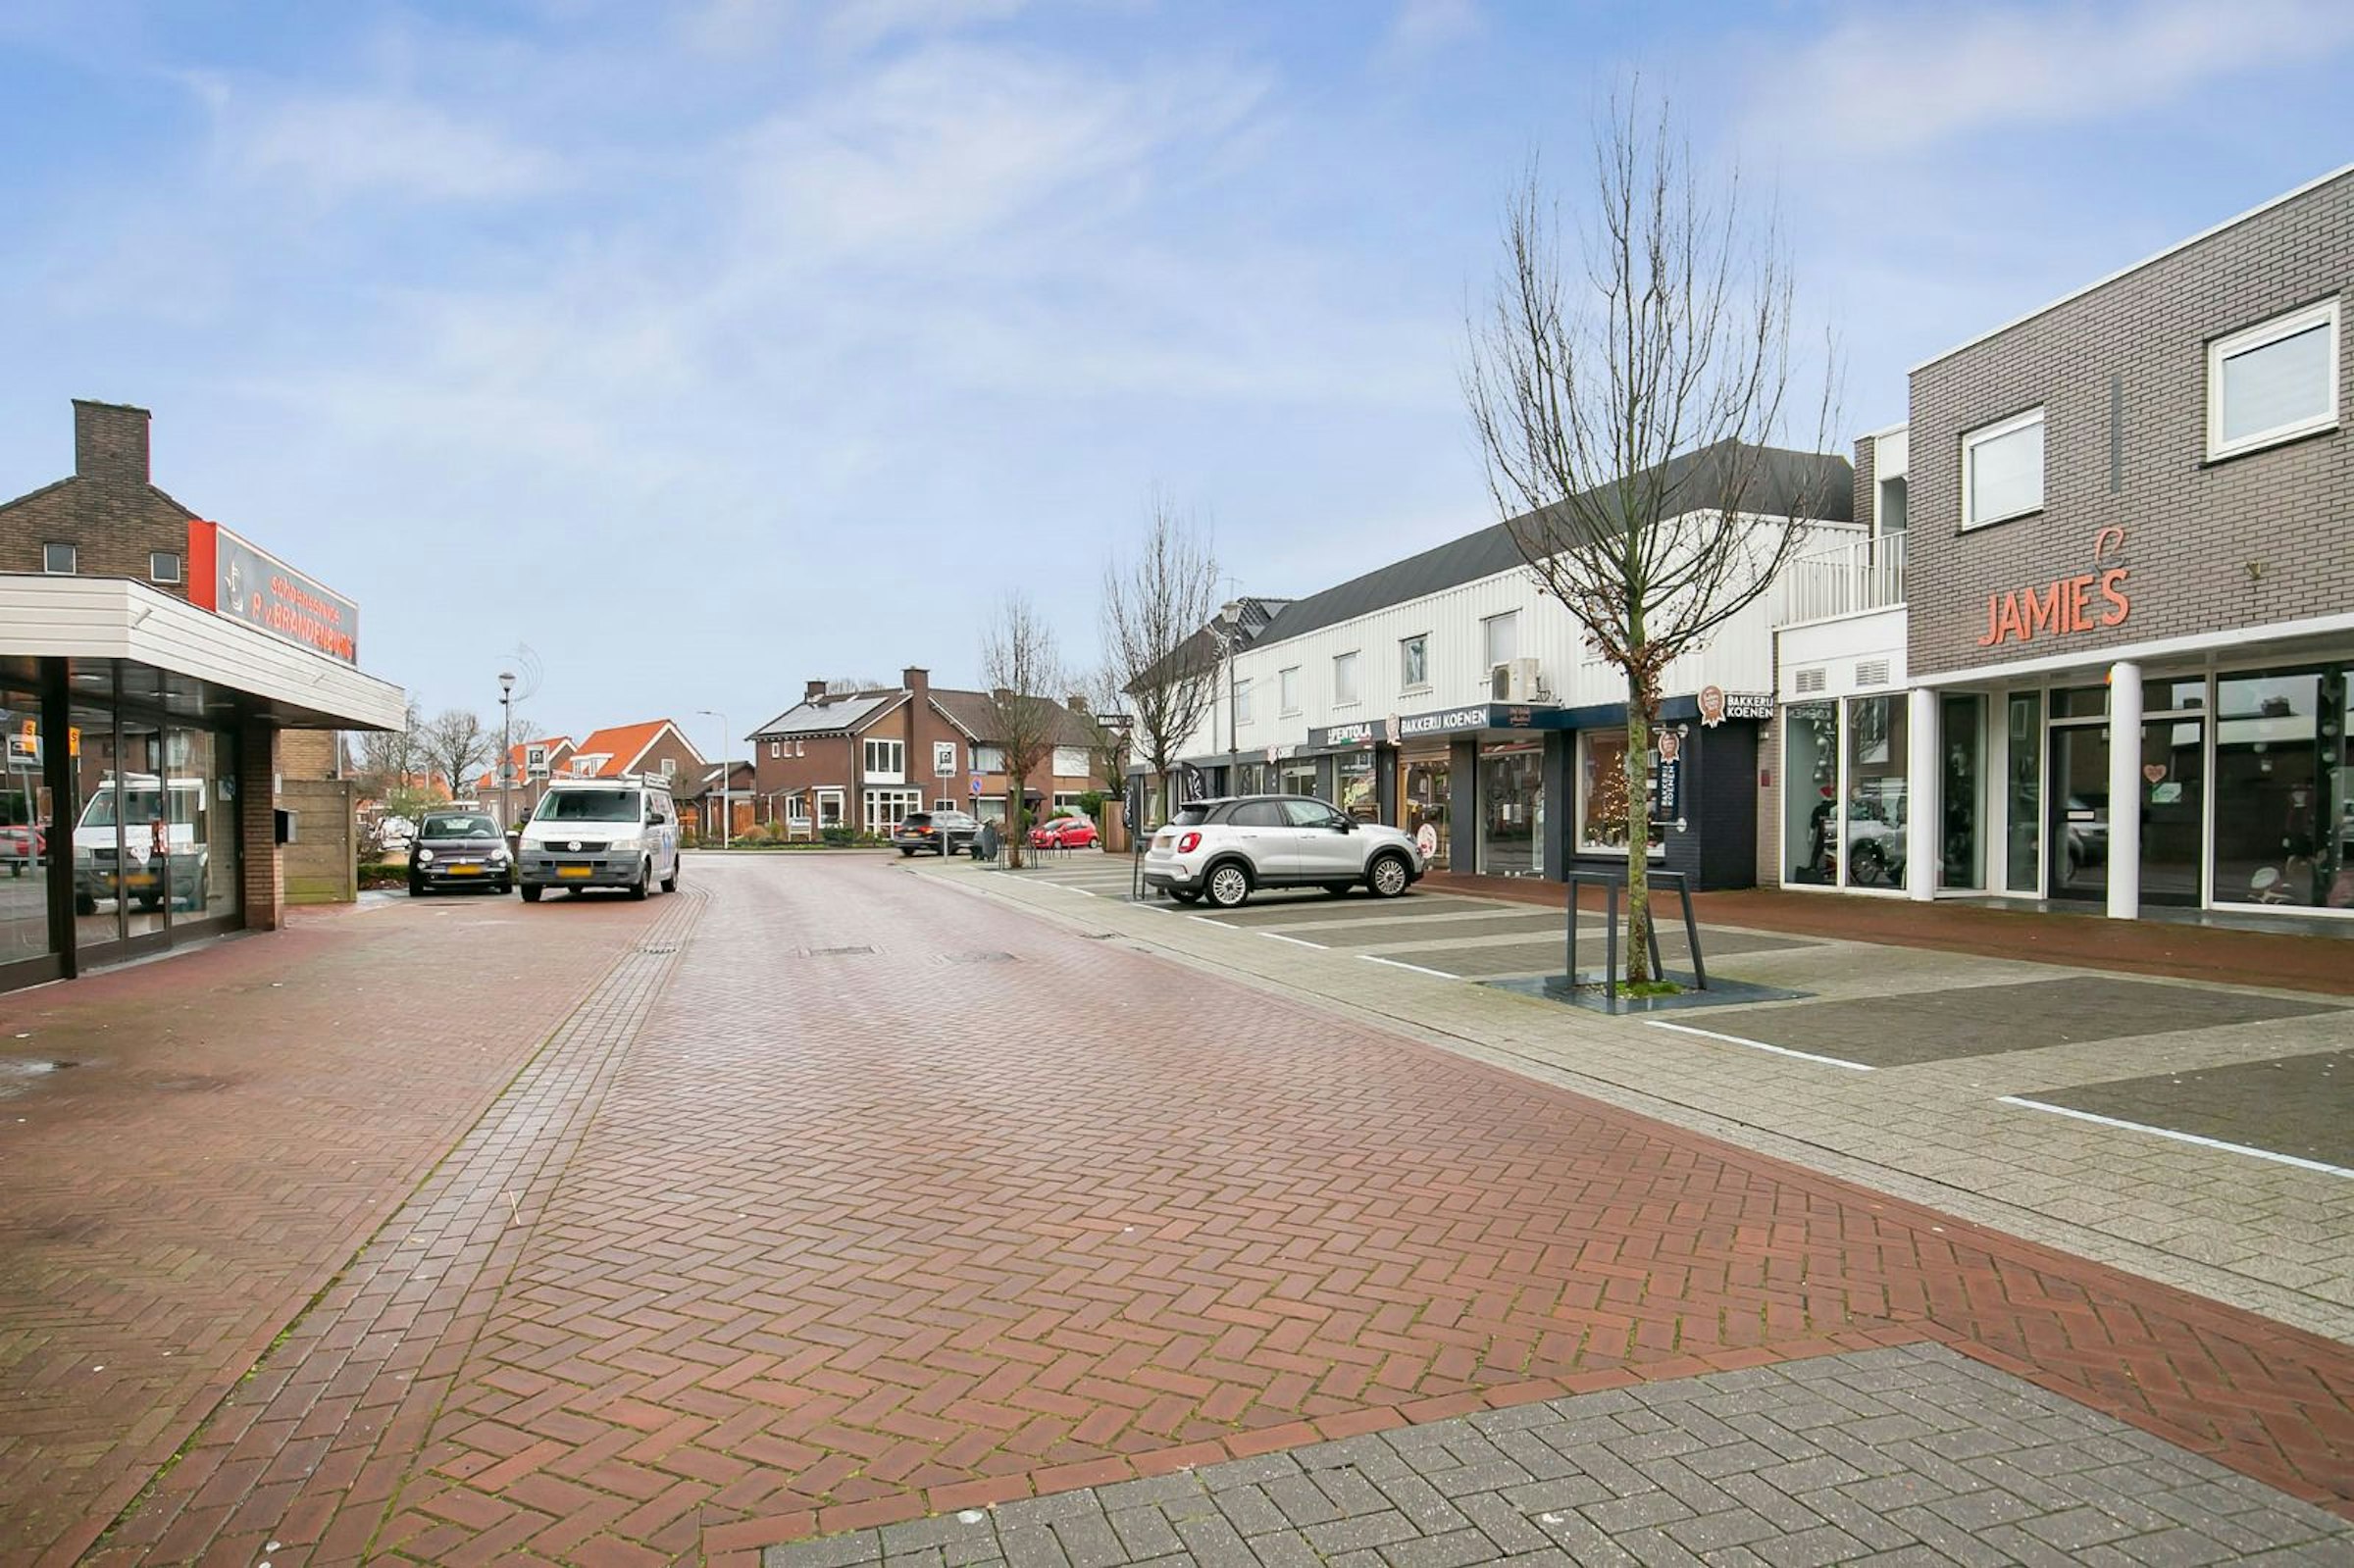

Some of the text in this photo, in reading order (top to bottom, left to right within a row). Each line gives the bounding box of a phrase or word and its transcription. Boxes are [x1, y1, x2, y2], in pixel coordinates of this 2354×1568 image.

[1726, 695, 1774, 707] BAKKERIJ
[1726, 706, 1773, 719] KOENEN
[1402, 714, 1442, 733] BAKKERIJ
[1443, 708, 1487, 728] KOENEN
